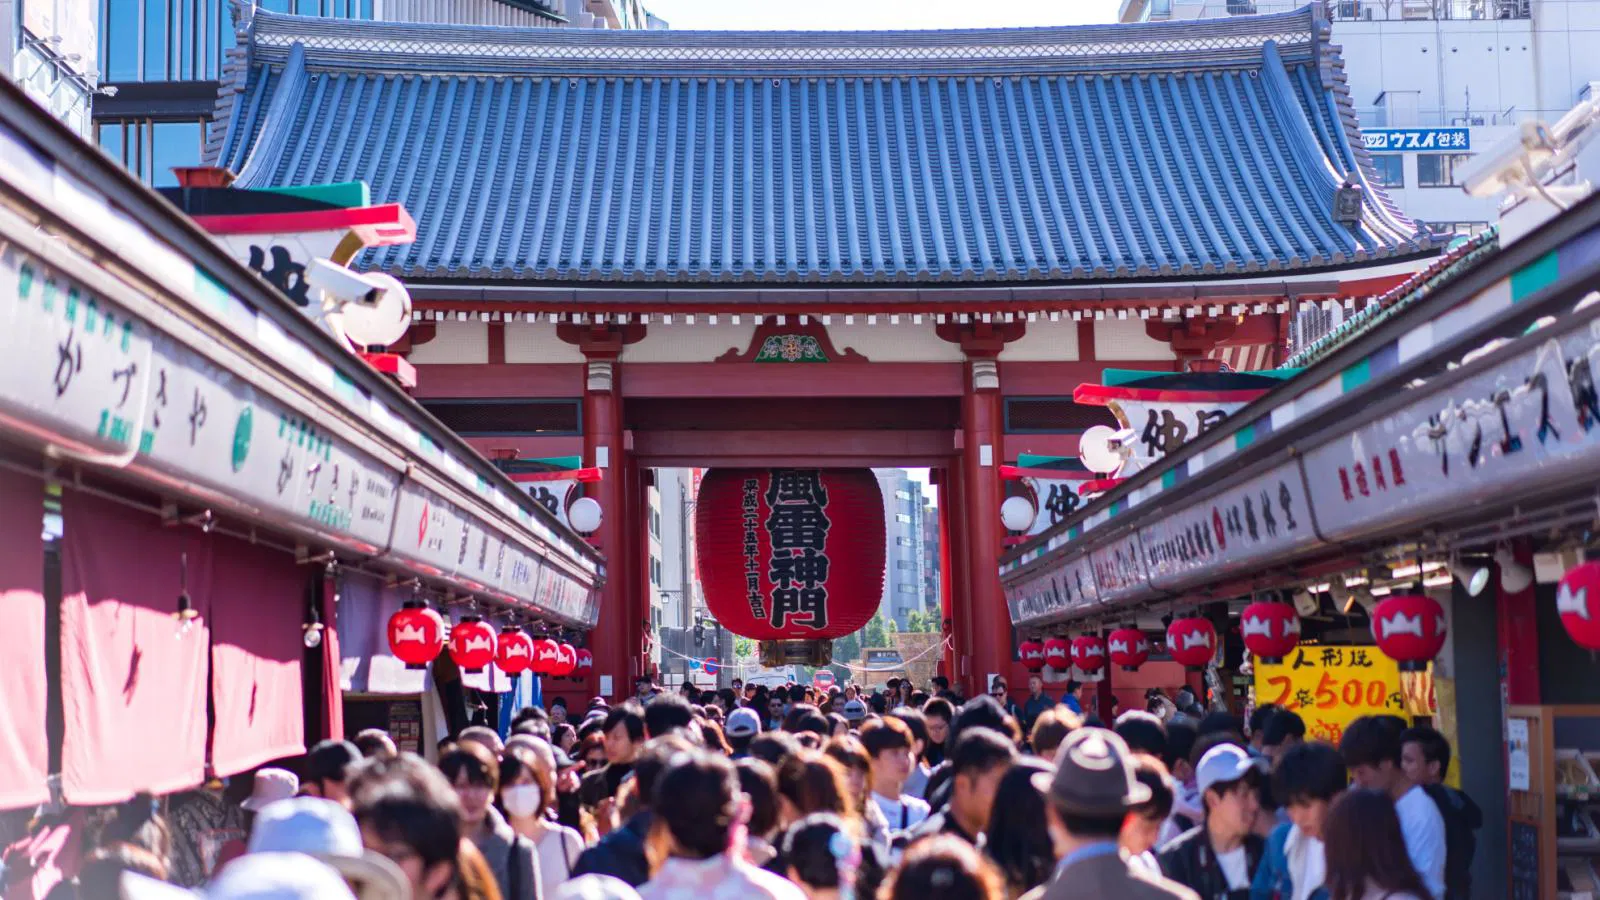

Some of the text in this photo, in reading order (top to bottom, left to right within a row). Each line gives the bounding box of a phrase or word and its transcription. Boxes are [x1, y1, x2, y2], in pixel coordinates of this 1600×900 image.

[1390, 132, 1466, 148] ウスイ包装
[764, 466, 832, 630] 風雷神門
[1293, 648, 1373, 670] 人形焼
